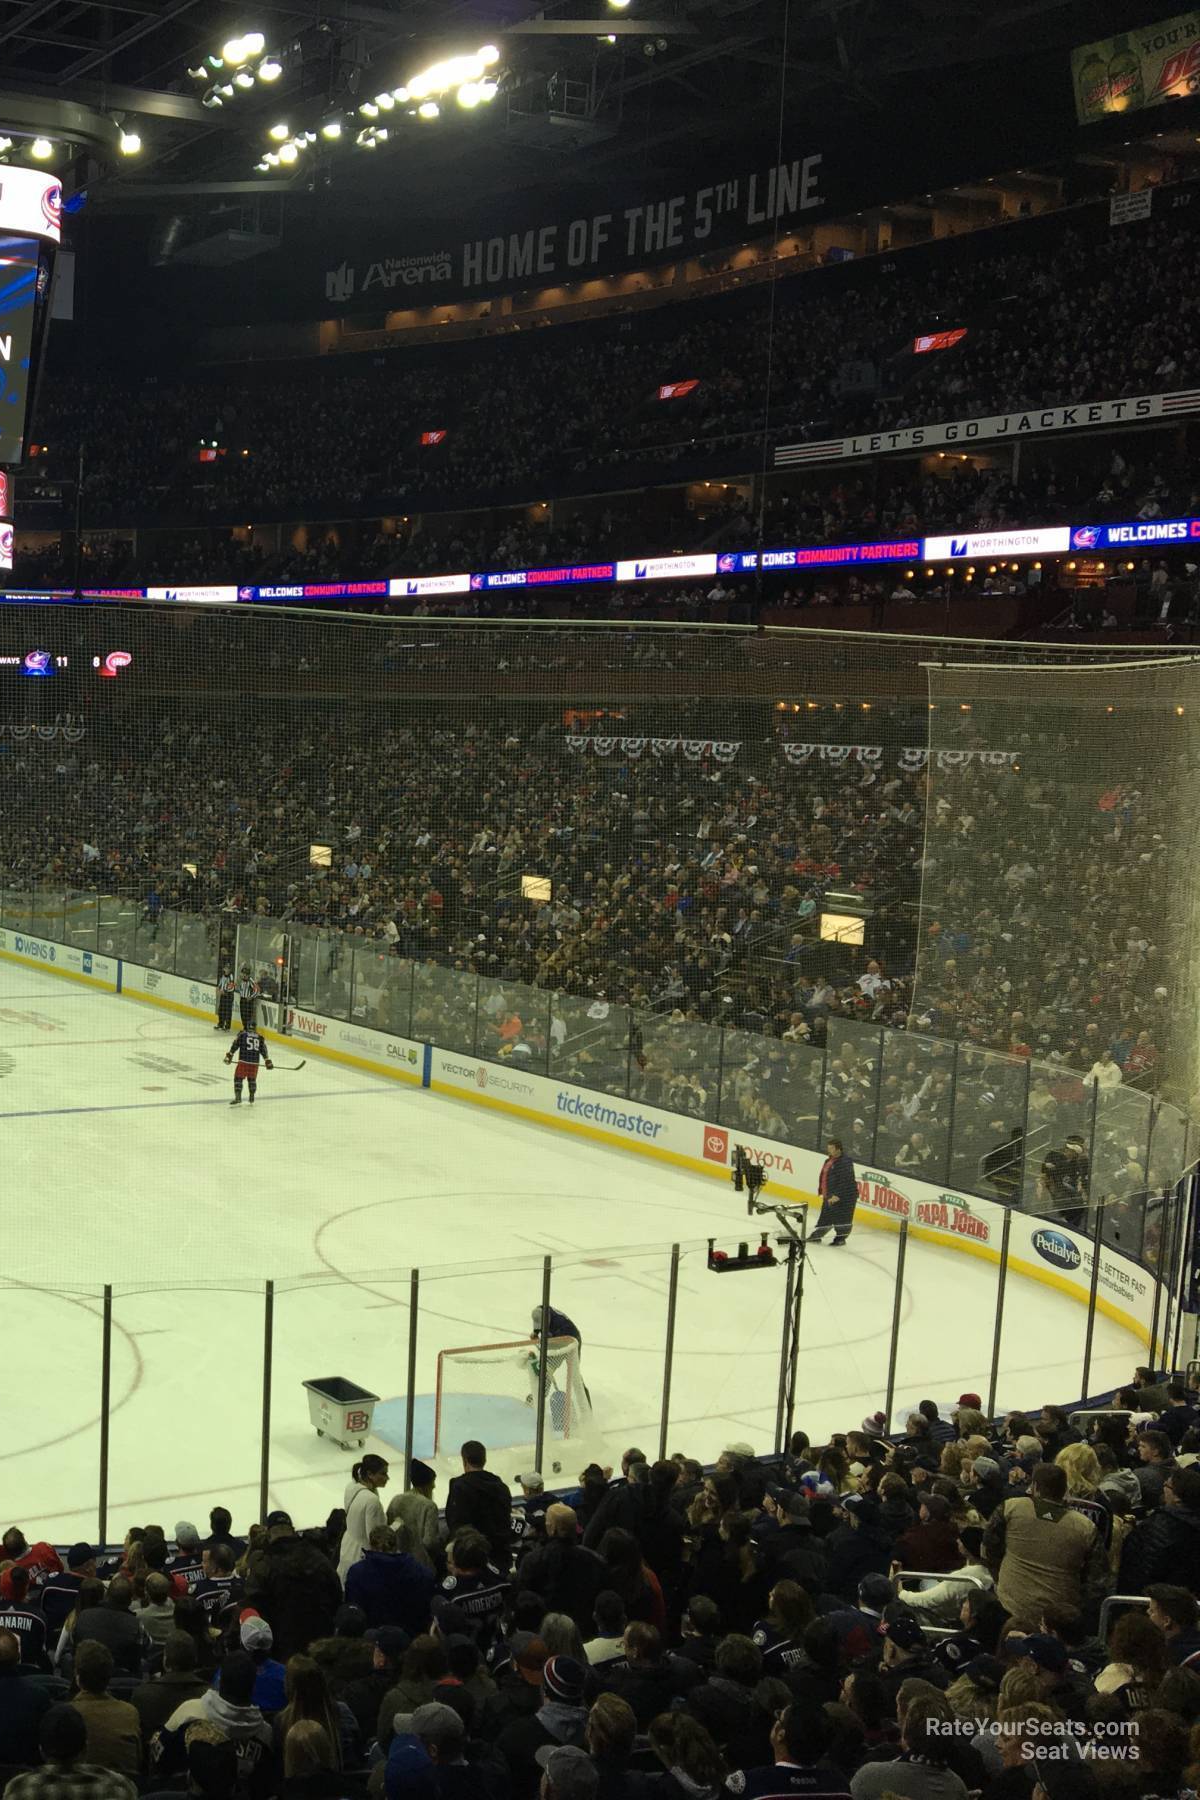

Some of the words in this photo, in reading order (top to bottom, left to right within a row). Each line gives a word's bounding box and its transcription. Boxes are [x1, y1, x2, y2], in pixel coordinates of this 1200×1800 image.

[1141, 22, 1200, 53] YOU'R
[463, 226, 558, 287] HOME
[567, 214, 612, 267] OF
[624, 196, 686, 256] THE
[694, 179, 738, 238] 5TH
[385, 250, 451, 269] Nationwide
[360, 262, 452, 291] Arena
[851, 430, 924, 453] LET'S
[946, 422, 979, 439] GO
[997, 400, 1151, 433] JACKETS
[972, 535, 1039, 549] WORTHINGTON
[1108, 523, 1187, 542] WELCOMES
[742, 552, 796, 569] WECOMES
[797, 546, 858, 564] COMMUNITY
[861, 542, 919, 559] PARTNERS
[259, 586, 303, 597] WELCOMES
[305, 585, 346, 596] COMMUNITY
[348, 583, 386, 593] PARTNERS
[488, 573, 526, 586] WELCOMES
[528, 569, 570, 582] COMMUNITY
[572, 566, 612, 580] PARTNERS
[56, 656, 68, 667] 11
[93, 656, 100, 667] 8
[298, 1015, 327, 1035] Wyler
[386, 1044, 406, 1057] CALL
[441, 1062, 475, 1080] VECTOR
[488, 1075, 534, 1095] SECURITY
[557, 1091, 662, 1138] ticketmaster
[744, 1147, 793, 1174] OYOTA
[872, 1184, 910, 1216] JOHNS
[917, 1203, 949, 1229] PAPA
[950, 1206, 989, 1241] JOHNS
[1036, 1234, 1081, 1264] Pedialyte
[1105, 1262, 1130, 1285] BETTER
[1131, 1277, 1147, 1296] FAST
